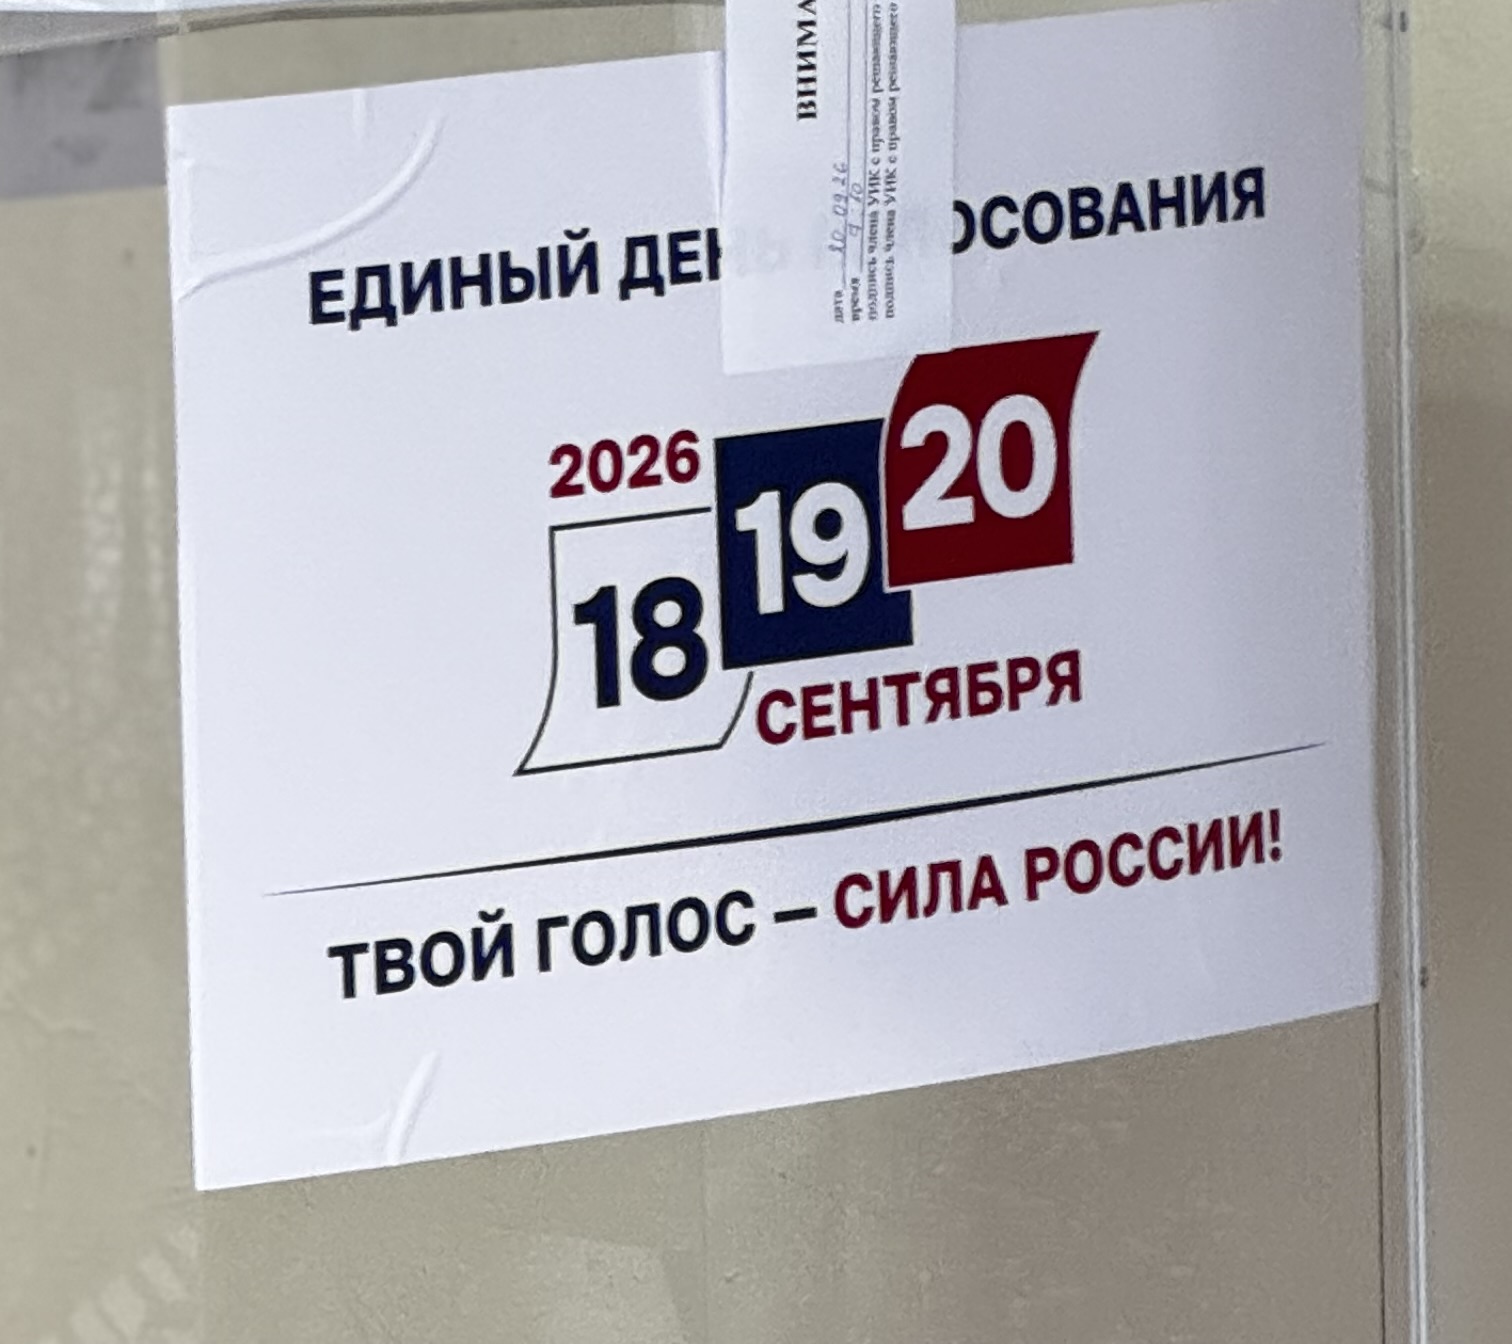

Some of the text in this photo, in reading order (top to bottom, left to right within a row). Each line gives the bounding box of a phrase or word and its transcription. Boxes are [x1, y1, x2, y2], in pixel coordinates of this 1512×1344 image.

[871, 97, 884, 153] правом
[888, 96, 900, 151] правом
[868, 169, 881, 207] УИК
[884, 168, 897, 206] УИК
[309, 167, 1265, 331] ЕДИНЫЙ ДЕ ОСОВАНИЯ
[867, 210, 880, 255] члена
[884, 210, 897, 253] члена
[833, 290, 845, 323] дата
[850, 277, 863, 322] время
[867, 256, 879, 321] подпись
[884, 255, 895, 319] подпись
[549, 429, 700, 498] 2026
[573, 394, 1057, 709] 18 19 20
[756, 649, 1082, 745] СЕНТЯБРЯ
[327, 909, 515, 999] ТВОЙ
[537, 891, 756, 973] ГОЛОС
[834, 854, 1009, 929] СИЛА
[1024, 808, 1282, 902] РОССИИ!
